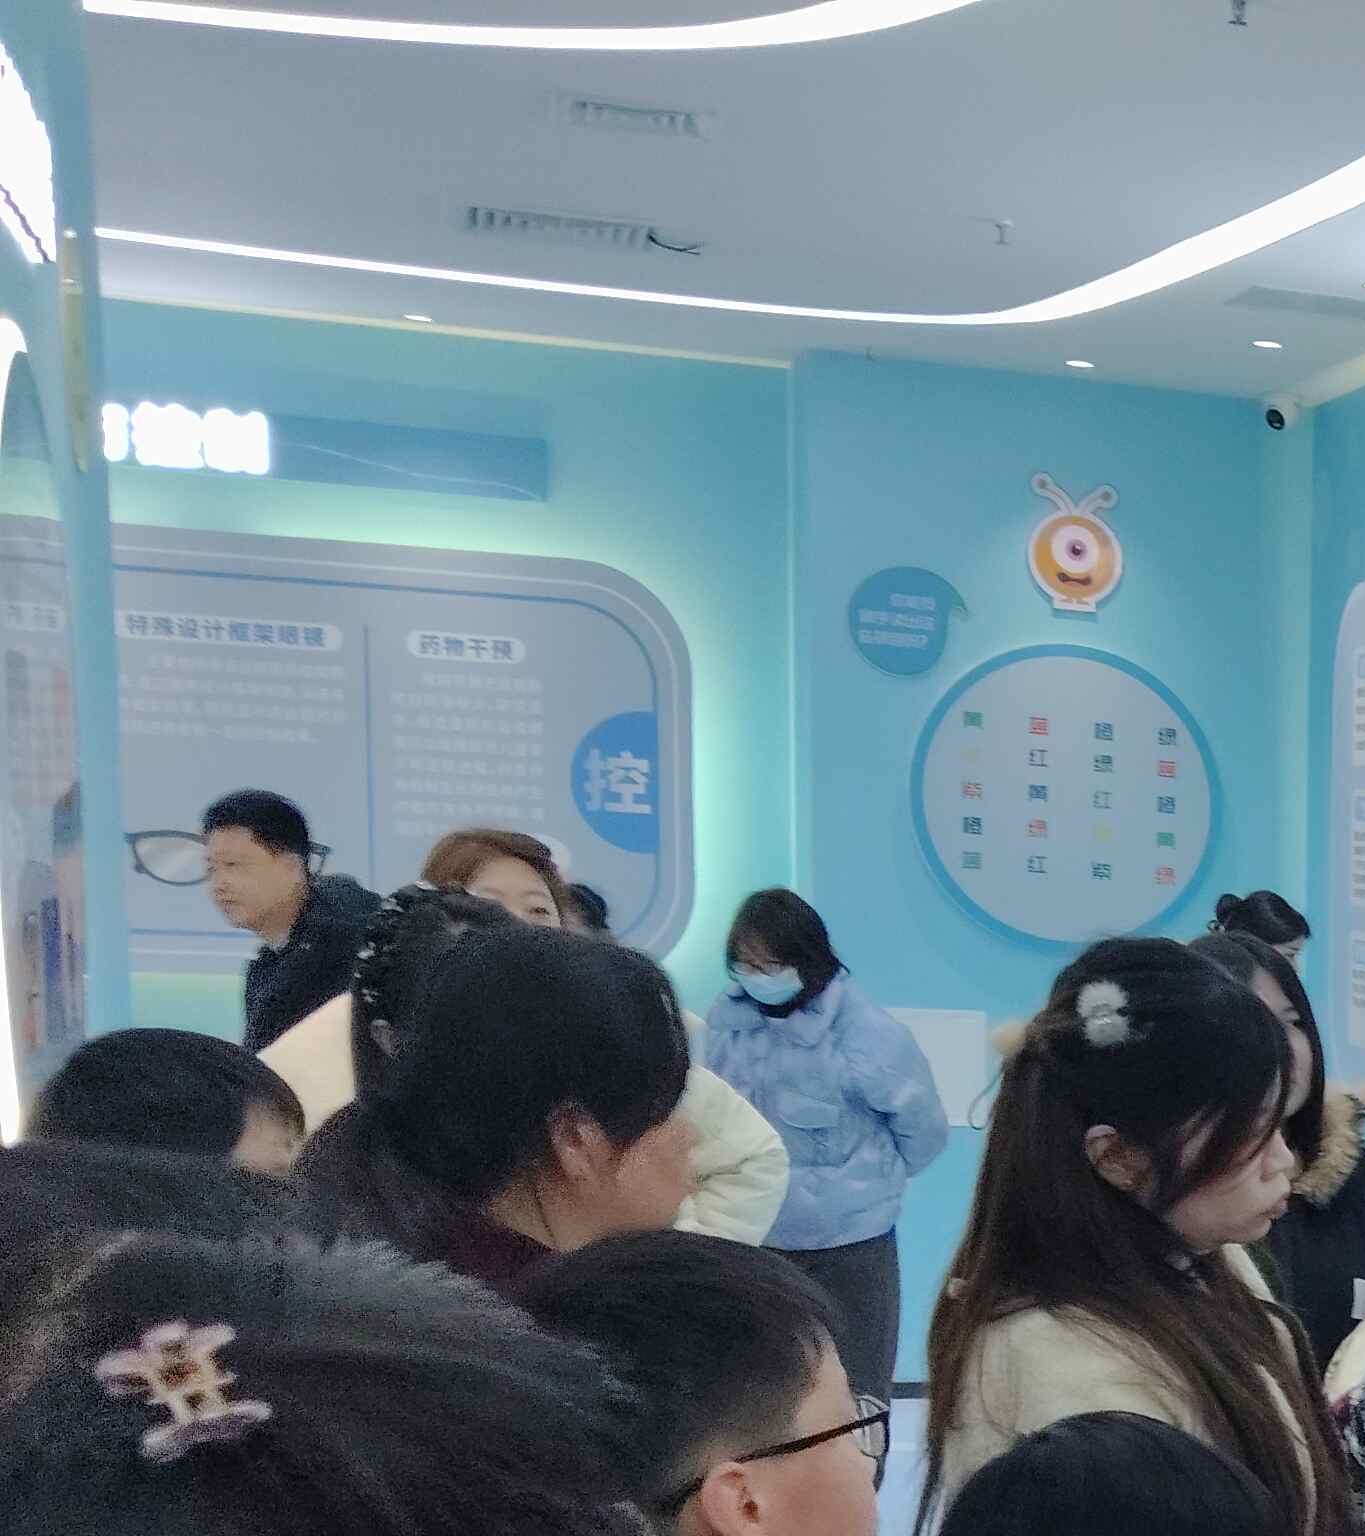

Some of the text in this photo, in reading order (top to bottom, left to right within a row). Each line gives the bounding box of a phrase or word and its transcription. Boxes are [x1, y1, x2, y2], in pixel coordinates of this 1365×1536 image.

[126, 613, 327, 648] 特殊设计框架眼镜
[419, 634, 514, 662] 药物干预
[583, 749, 651, 814] 控
